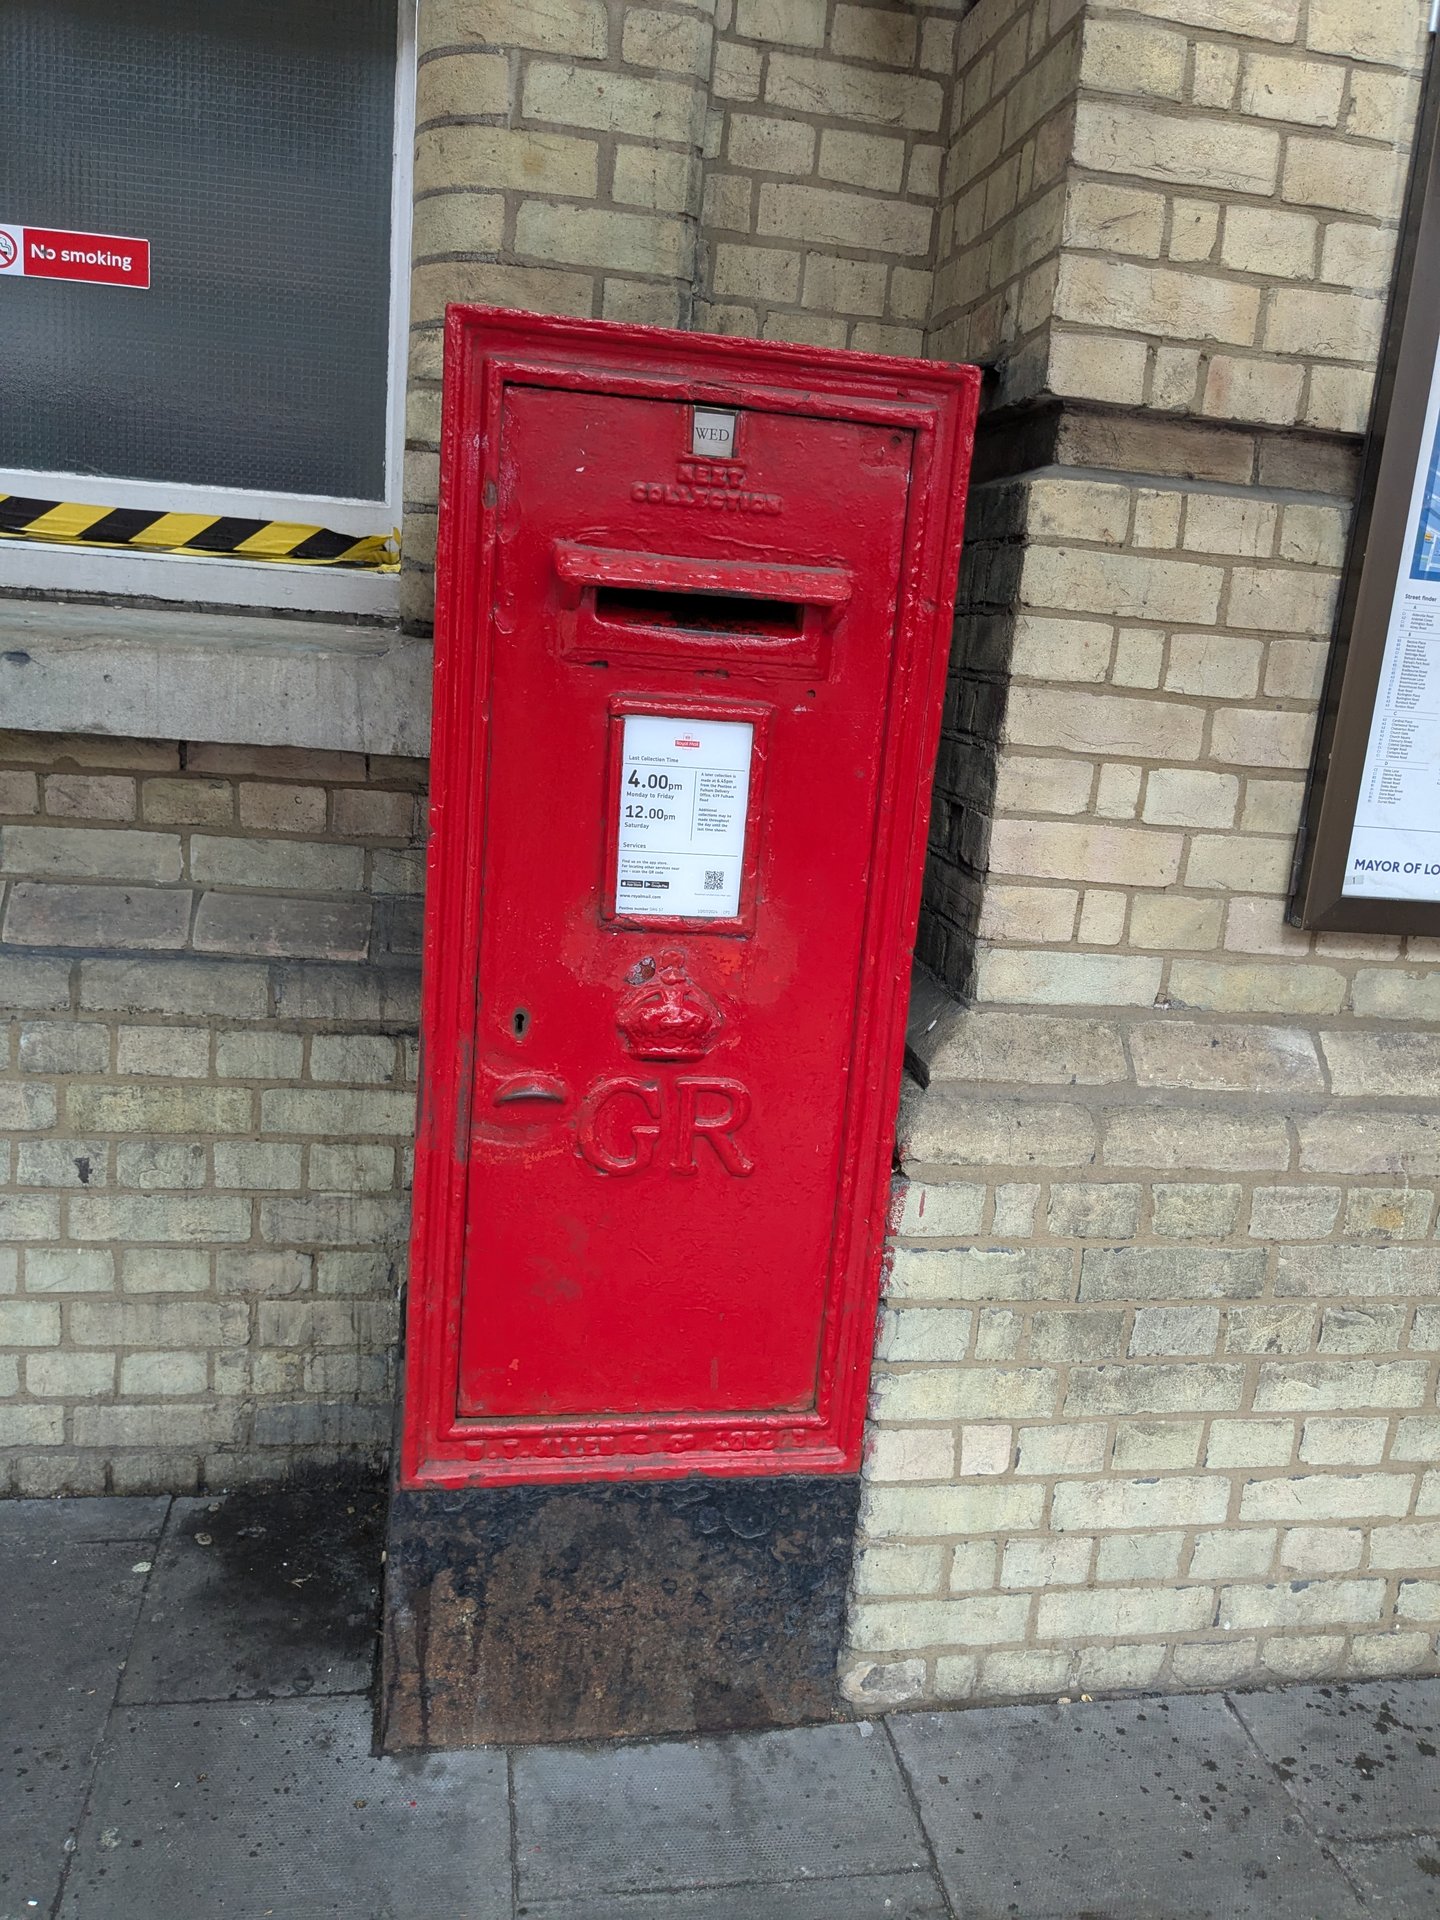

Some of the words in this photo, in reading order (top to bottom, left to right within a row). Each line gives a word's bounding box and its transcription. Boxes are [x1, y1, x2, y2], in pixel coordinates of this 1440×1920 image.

[31, 243, 56, 260] No
[61, 249, 132, 271] smoking
[695, 427, 730, 442] WED
[629, 755, 639, 763] Last
[628, 769, 683, 791] 4.00pm
[626, 791, 648, 799] Monday
[657, 792, 674, 800] Friday
[625, 805, 676, 821] 12.00pm
[624, 822, 649, 830] Saturday
[1354, 859, 1400, 873] MAYOR
[1403, 862, 1422, 874] OF
[577, 1076, 754, 1177] GR
